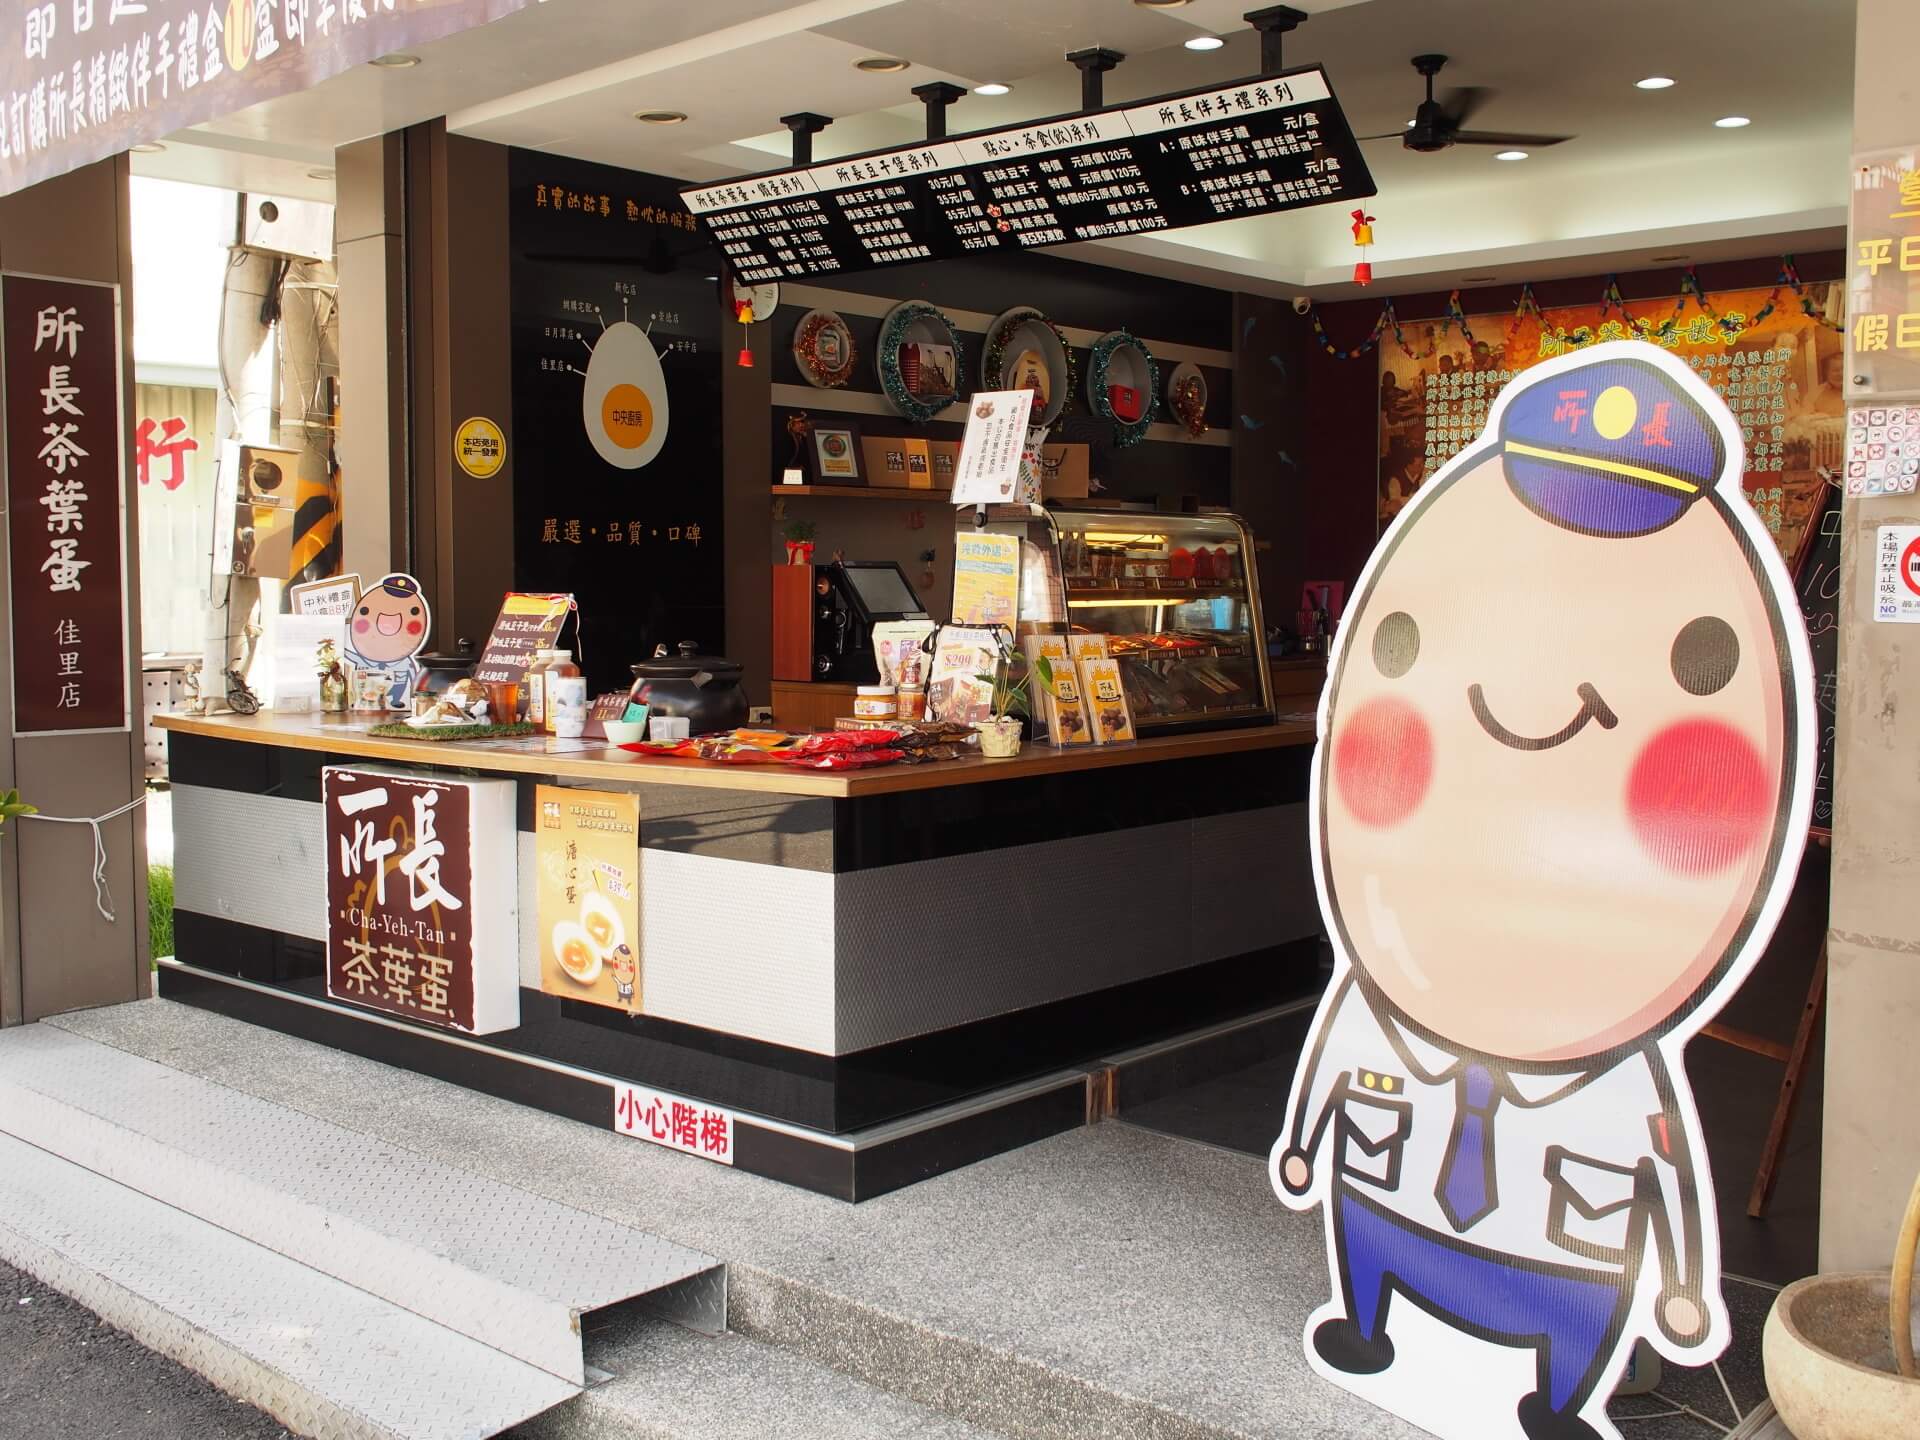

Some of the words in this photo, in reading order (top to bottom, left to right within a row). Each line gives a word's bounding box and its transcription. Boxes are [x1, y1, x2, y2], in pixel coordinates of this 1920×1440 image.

[1155, 82, 1295, 125] 所長伴手禮系列
[1281, 111, 1320, 130] 元/盒
[833, 150, 939, 183] 所長豆干堡系列
[1037, 159, 1064, 173] 特價
[1303, 156, 1341, 175] 元/盒
[1046, 175, 1073, 190] 特價
[536, 184, 611, 217] 真實的故事
[781, 199, 821, 214] 110元/包
[790, 213, 829, 228] 120元/包
[789, 234, 801, 243] 元
[799, 230, 823, 242] 120元
[797, 248, 810, 257] 元
[808, 244, 833, 256] 120元
[806, 261, 819, 271] 元
[817, 258, 842, 270] 120元
[612, 409, 643, 426] 中央廚房
[34, 306, 91, 592] 所長茶葉蛋
[136, 417, 198, 490] 行
[1880, 605, 1897, 613] NO
[54, 619, 84, 709] 佳里店
[338, 787, 463, 911] 所長
[350, 907, 446, 945] Cha-Yeh-Tan
[341, 937, 455, 1018] 茶葉蛋
[618, 1088, 728, 1155] 小心階梯
